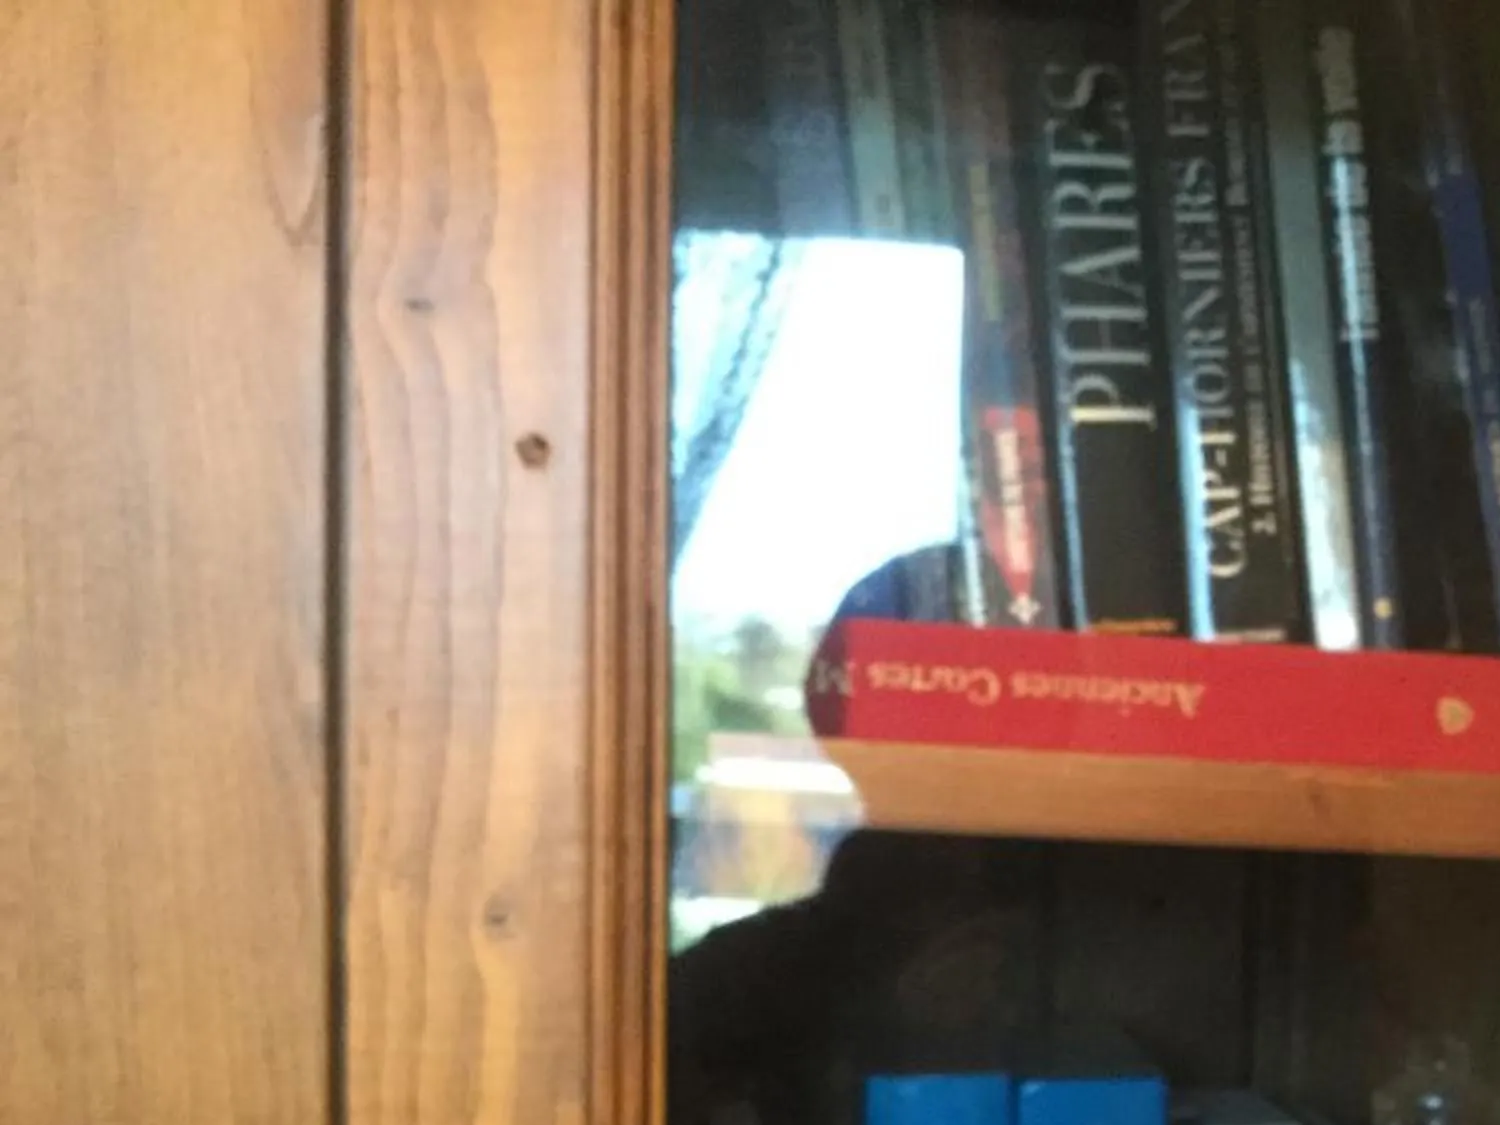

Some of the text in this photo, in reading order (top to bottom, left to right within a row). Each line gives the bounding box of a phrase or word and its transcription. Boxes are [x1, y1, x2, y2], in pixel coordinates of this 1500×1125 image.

[1044, 62, 1157, 430] PHARES
[1175, 157, 1246, 577] CAP-HORNIERS
[865, 662, 1000, 706] Cartes
[1010, 672, 1205, 718] Anciennes
